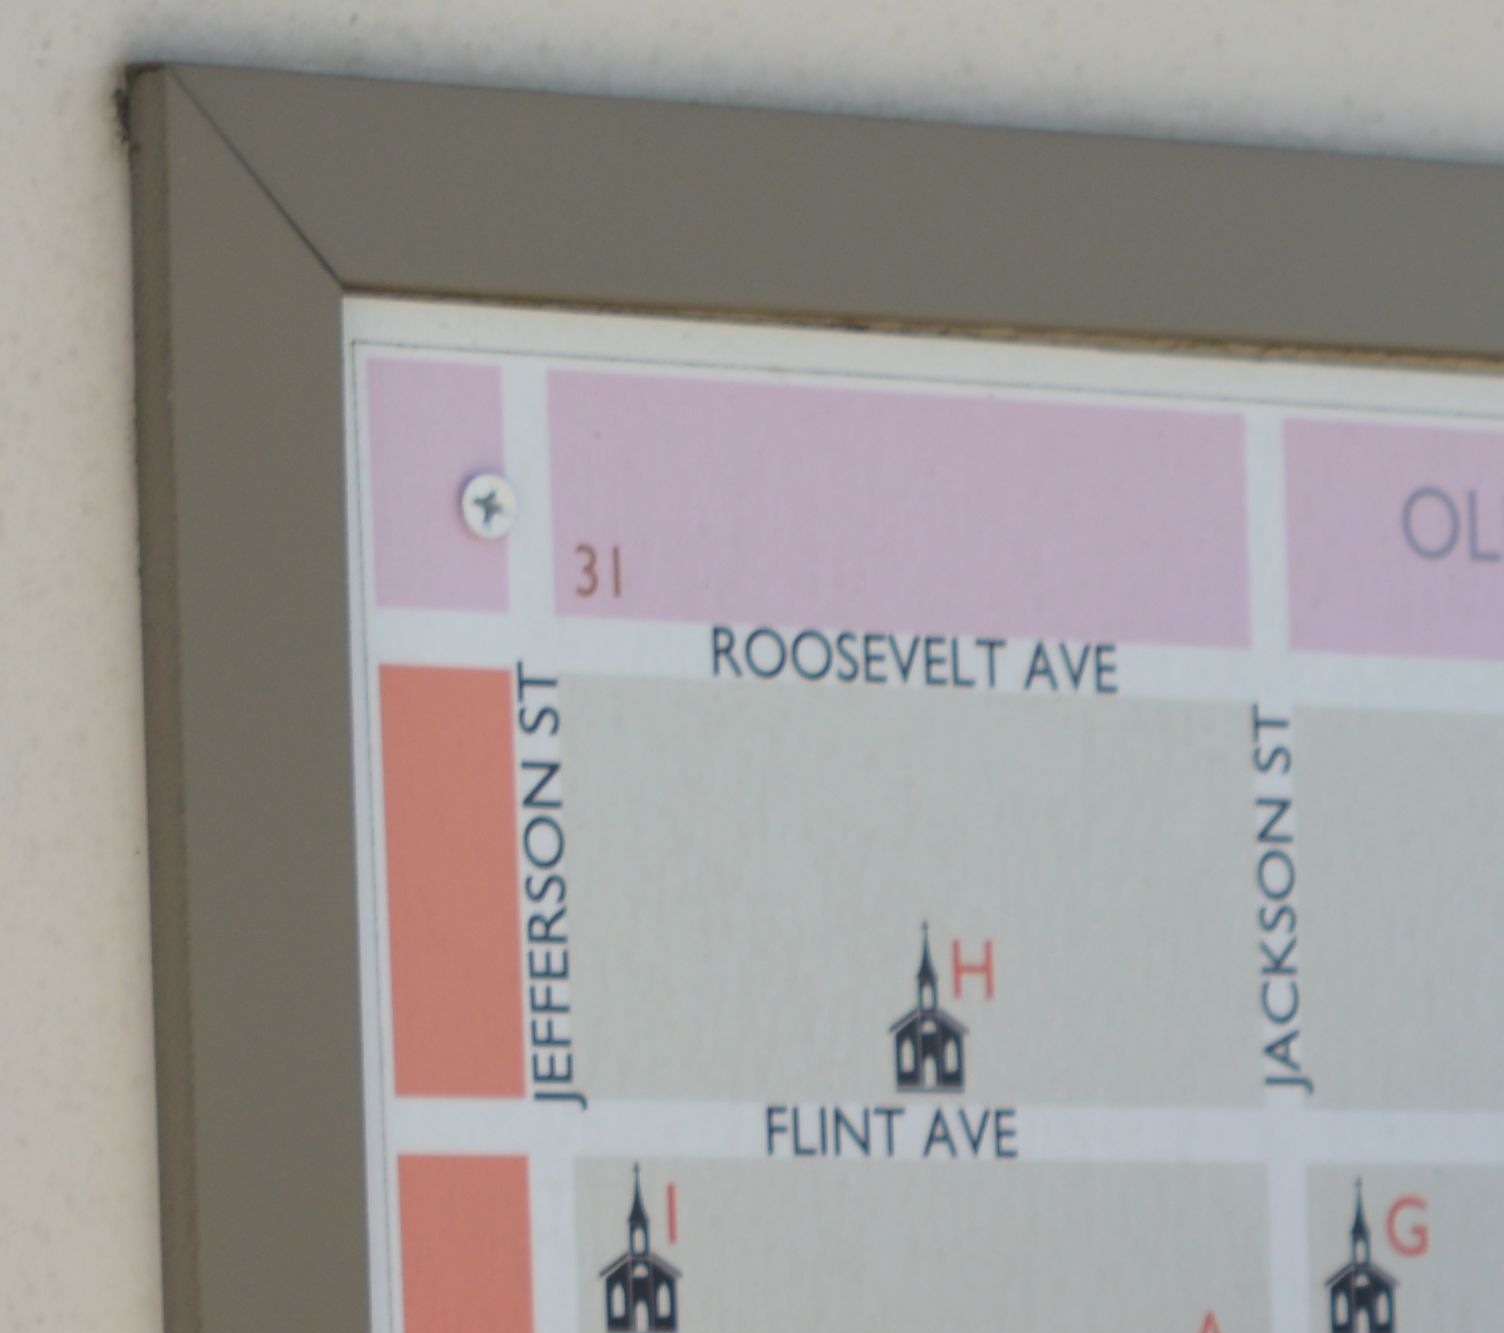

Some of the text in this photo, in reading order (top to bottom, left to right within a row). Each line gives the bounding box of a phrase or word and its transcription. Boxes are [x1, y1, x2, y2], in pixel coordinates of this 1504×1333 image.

[573, 545, 622, 599] 31
[710, 625, 1119, 695] ROOSEVELT AVE
[517, 660, 588, 1111] JEFFERSON ST
[1252, 704, 1314, 1095] JACKSON ST
[951, 937, 995, 999] H
[764, 1105, 1019, 1161] FLINT AVE
[1386, 1196, 1430, 1258] G
